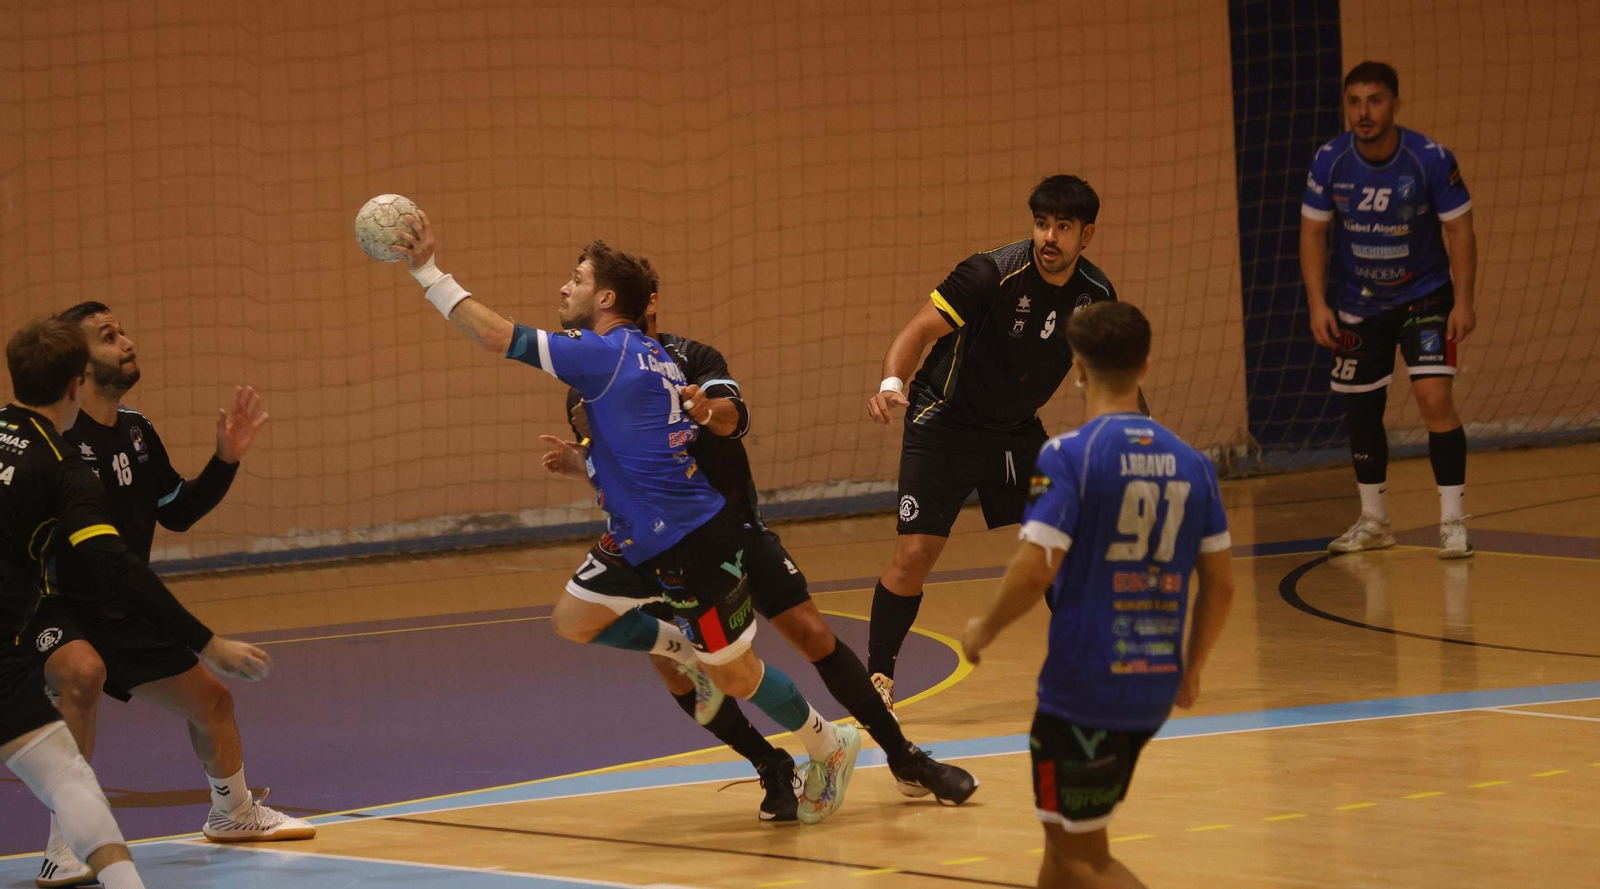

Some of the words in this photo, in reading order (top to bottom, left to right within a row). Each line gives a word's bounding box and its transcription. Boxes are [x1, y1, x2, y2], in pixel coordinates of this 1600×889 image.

[1357, 187, 1393, 212] 26
[1039, 310, 1057, 340] 9
[637, 352, 649, 371] J.
[1331, 356, 1359, 381] 26
[111, 452, 133, 487] 18
[1104, 479, 1191, 562] 91
[574, 552, 608, 581] 17
